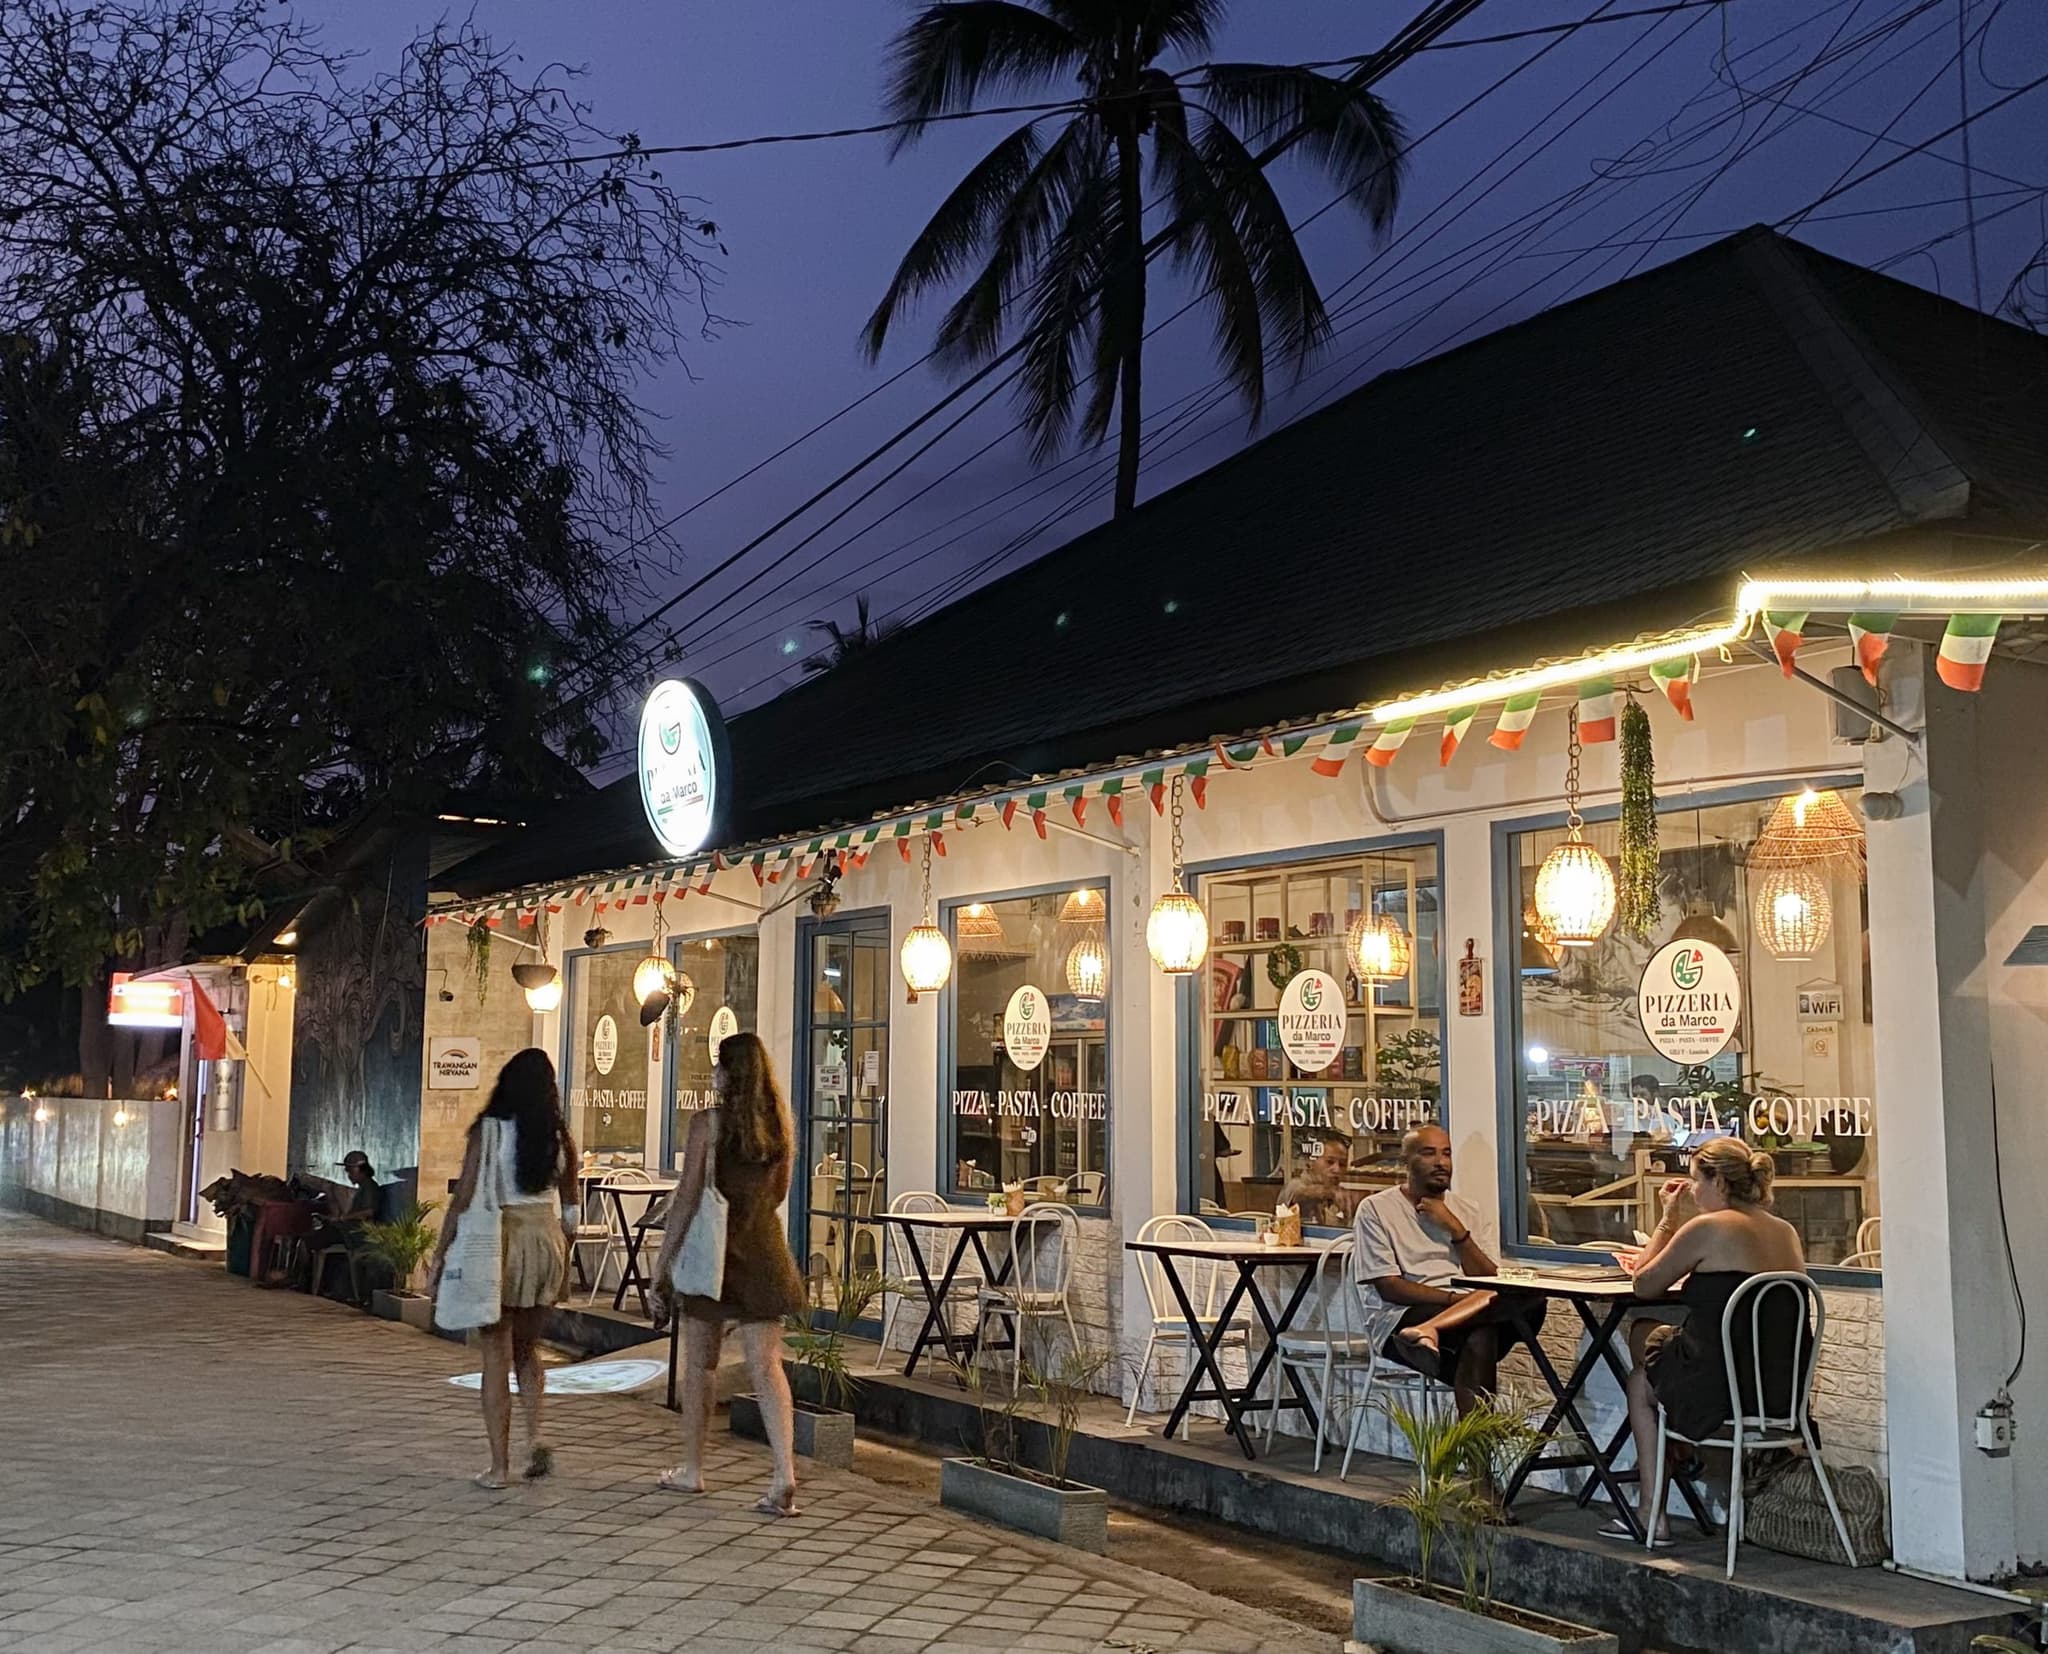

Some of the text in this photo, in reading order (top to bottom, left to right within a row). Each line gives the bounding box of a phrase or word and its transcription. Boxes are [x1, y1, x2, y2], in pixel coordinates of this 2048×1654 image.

[1645, 992, 1733, 1013] PIZZERIA
[1811, 1000, 1840, 1014] WiFi
[1282, 1014, 1342, 1030] PIZZERIA
[1661, 1014, 1717, 1027] da Marco
[1006, 1022, 1047, 1036] PIZZERIA
[1292, 1031, 1331, 1041] da Marco
[433, 1061, 478, 1069] TRAWANGAN
[439, 1069, 470, 1077] NIRVANA
[592, 1088, 614, 1108] PASTA
[619, 1089, 647, 1109] COFFEE
[676, 1089, 698, 1110] PIZZA
[952, 1090, 988, 1115] PIZZA
[998, 1090, 1040, 1117] PASTA
[1050, 1091, 1106, 1120] COFFEE
[1203, 1092, 1255, 1125] PIZZA
[1270, 1094, 1331, 1128] PASTA
[1349, 1097, 1432, 1130] COFFEE
[1535, 1096, 1610, 1135] PIZZA
[1632, 1096, 1722, 1135] PASTA
[1749, 1096, 1873, 1137] COFFEE
